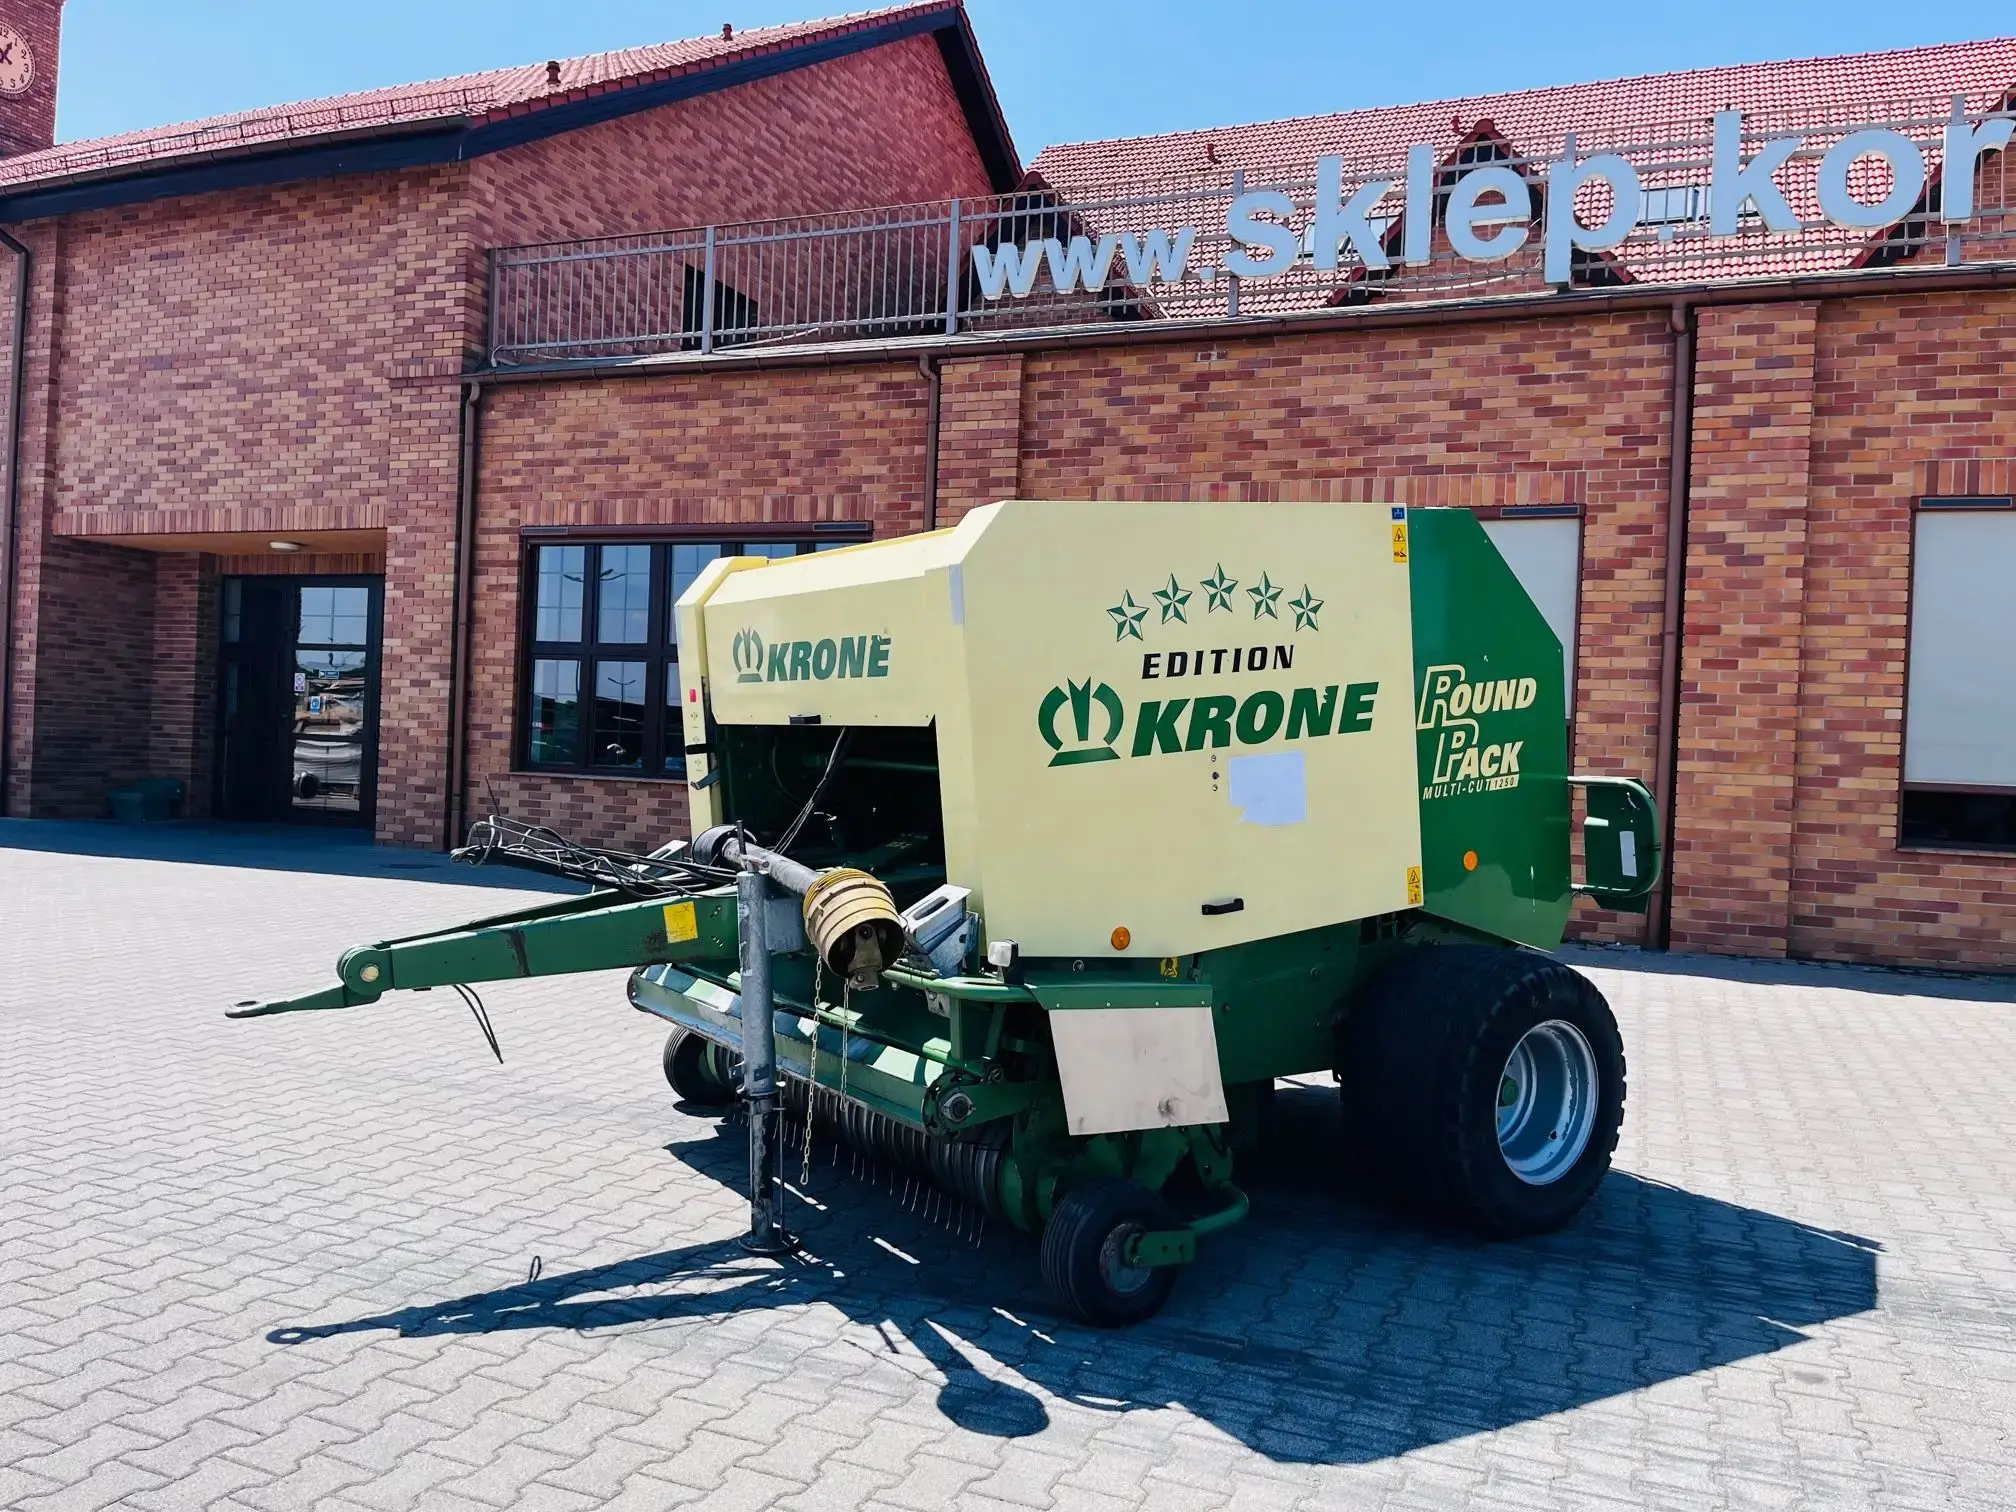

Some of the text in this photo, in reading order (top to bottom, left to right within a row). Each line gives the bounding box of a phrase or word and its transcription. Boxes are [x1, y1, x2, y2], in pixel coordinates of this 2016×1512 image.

[21, 49, 27, 60] 2
[23, 63, 30, 73] 3
[10, 78, 16, 88] 5
[972, 109, 2016, 300] www.sklep.kor
[766, 634, 892, 682] KRONE
[1141, 644, 1295, 680] EDITION
[1416, 664, 1537, 730] ROUND
[1131, 681, 1379, 758] KRONE
[1432, 718, 1524, 784] PACK
[1422, 776, 1515, 801] MULTI-CUT 1250
